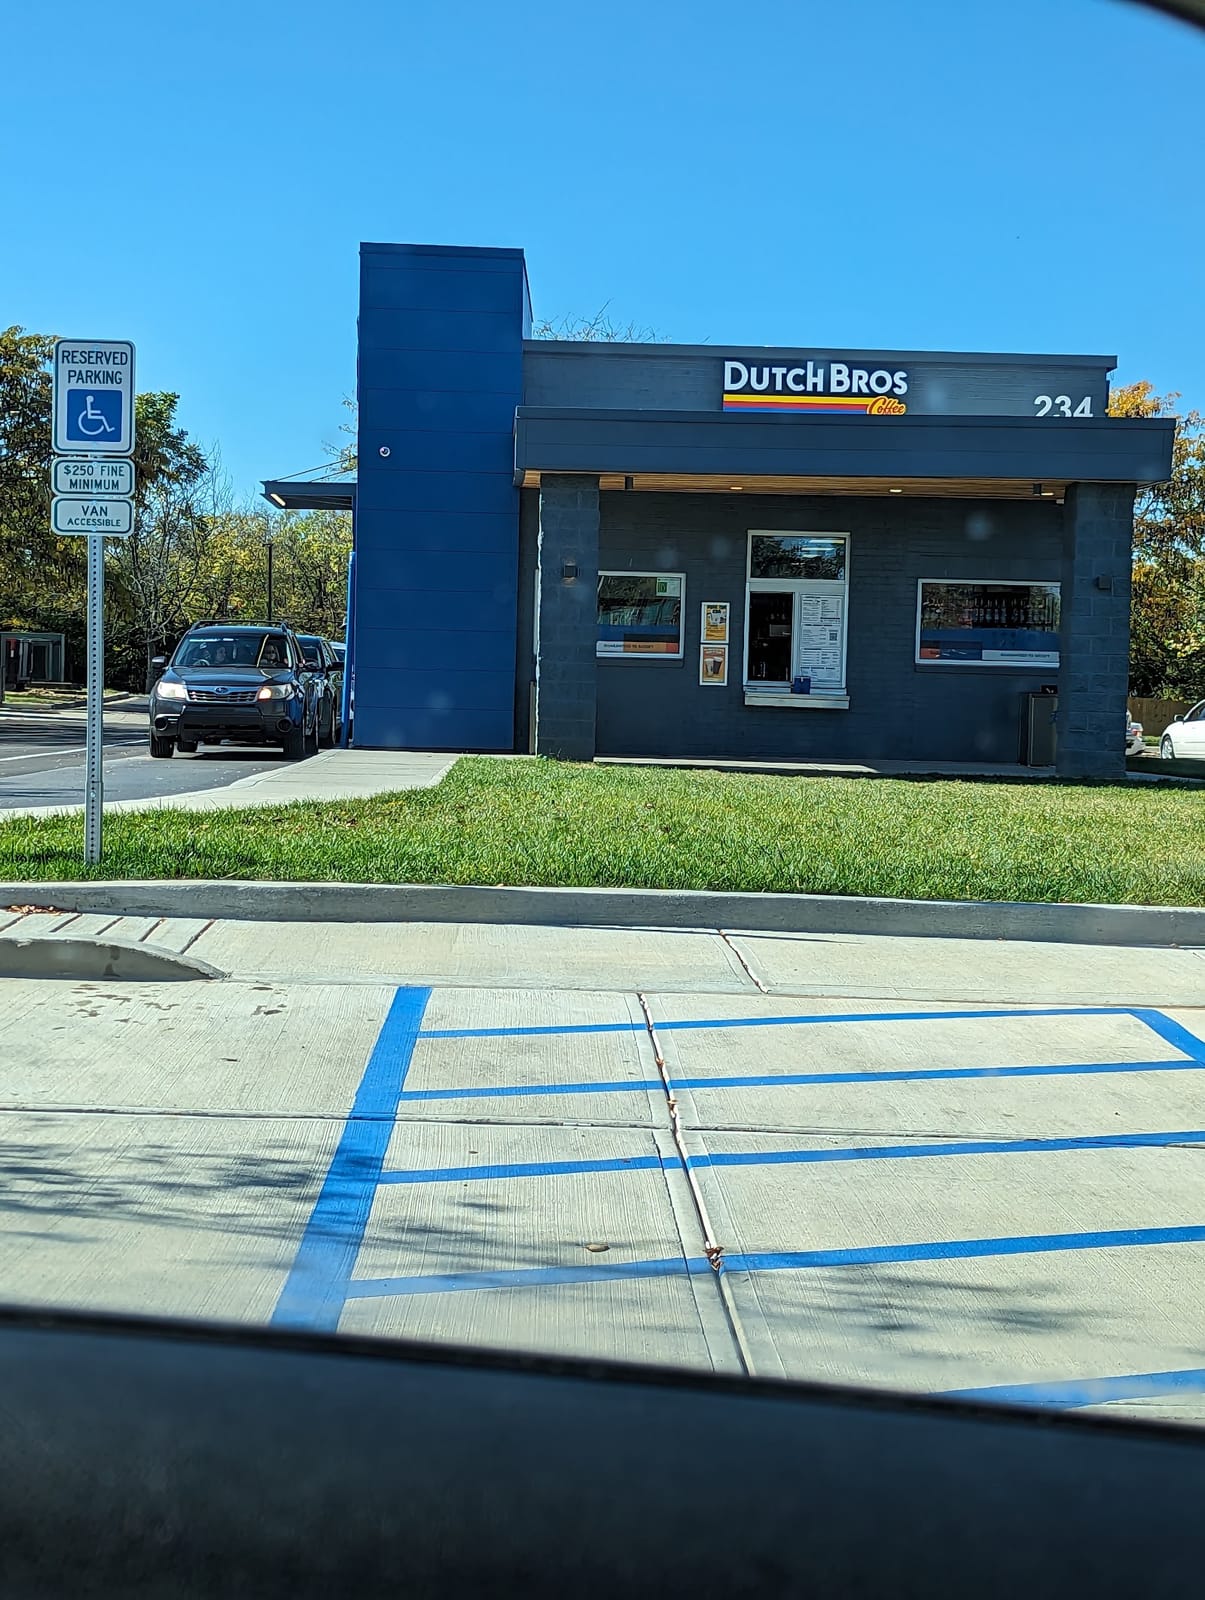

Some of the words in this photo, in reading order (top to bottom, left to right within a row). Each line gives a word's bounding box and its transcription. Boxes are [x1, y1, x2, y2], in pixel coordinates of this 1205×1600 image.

[61, 350, 128, 366] RESERVED
[67, 369, 123, 385] PARKING
[830, 363, 908, 395] BROS
[1034, 395, 1094, 417] 234
[63, 465, 94, 477] $250
[101, 465, 125, 477] FINE
[69, 479, 120, 491] MINIMUM
[82, 505, 108, 517] VAN
[67, 517, 121, 527] ACCESSIBLE
